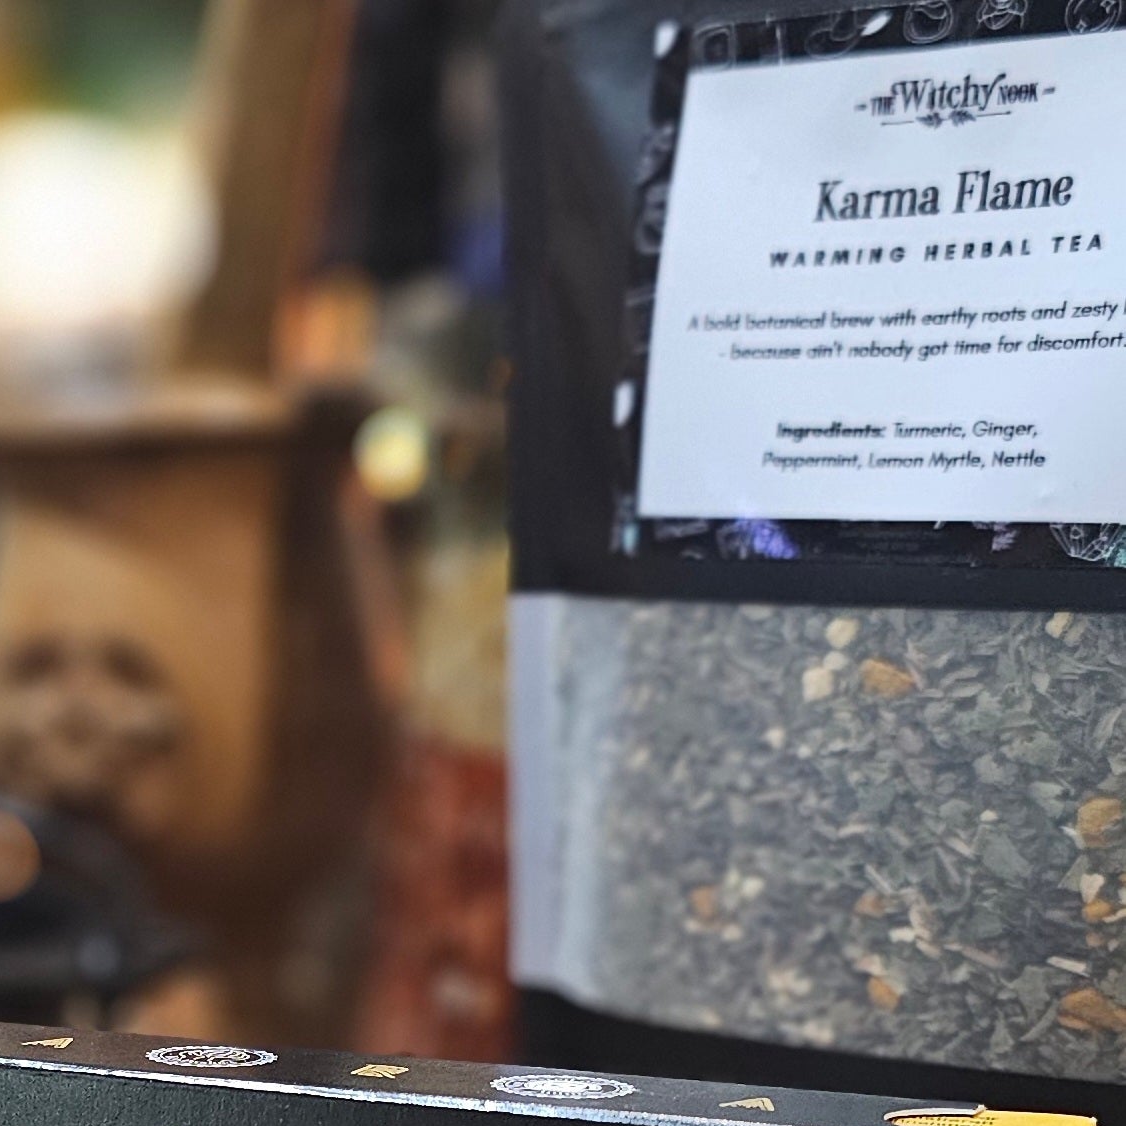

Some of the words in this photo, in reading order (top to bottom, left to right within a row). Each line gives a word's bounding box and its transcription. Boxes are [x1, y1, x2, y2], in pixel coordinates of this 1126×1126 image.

[870, 96, 897, 116] THE
[891, 73, 1007, 113] Witchy
[813, 180, 940, 222] Karma
[952, 169, 1075, 214] Flame
[770, 246, 905, 268] WARMING
[924, 238, 1031, 262] HERBAL
[1051, 234, 1103, 254] TEA
[687, 314, 700, 331] A
[703, 313, 741, 331] bold
[745, 311, 827, 331] botanical
[830, 311, 875, 329] brew
[879, 309, 916, 327] with
[921, 307, 977, 329] earthy
[981, 306, 1026, 324] roots
[1031, 300, 1068, 320] and
[1073, 301, 1119, 322] zesty
[730, 343, 801, 361] because
[806, 341, 844, 360] ain't
[848, 340, 914, 363] nobody
[918, 341, 949, 362] got
[954, 339, 992, 356] time
[997, 335, 1023, 354] for
[776, 421, 886, 443] Ingredients:
[892, 422, 967, 440] Turmeric,
[972, 420, 1039, 441] Ginger,
[762, 452, 863, 473] Peppermint,
[867, 452, 924, 470] Lemon
[928, 450, 987, 473] Myrtle,
[991, 449, 1047, 468] Nettle
